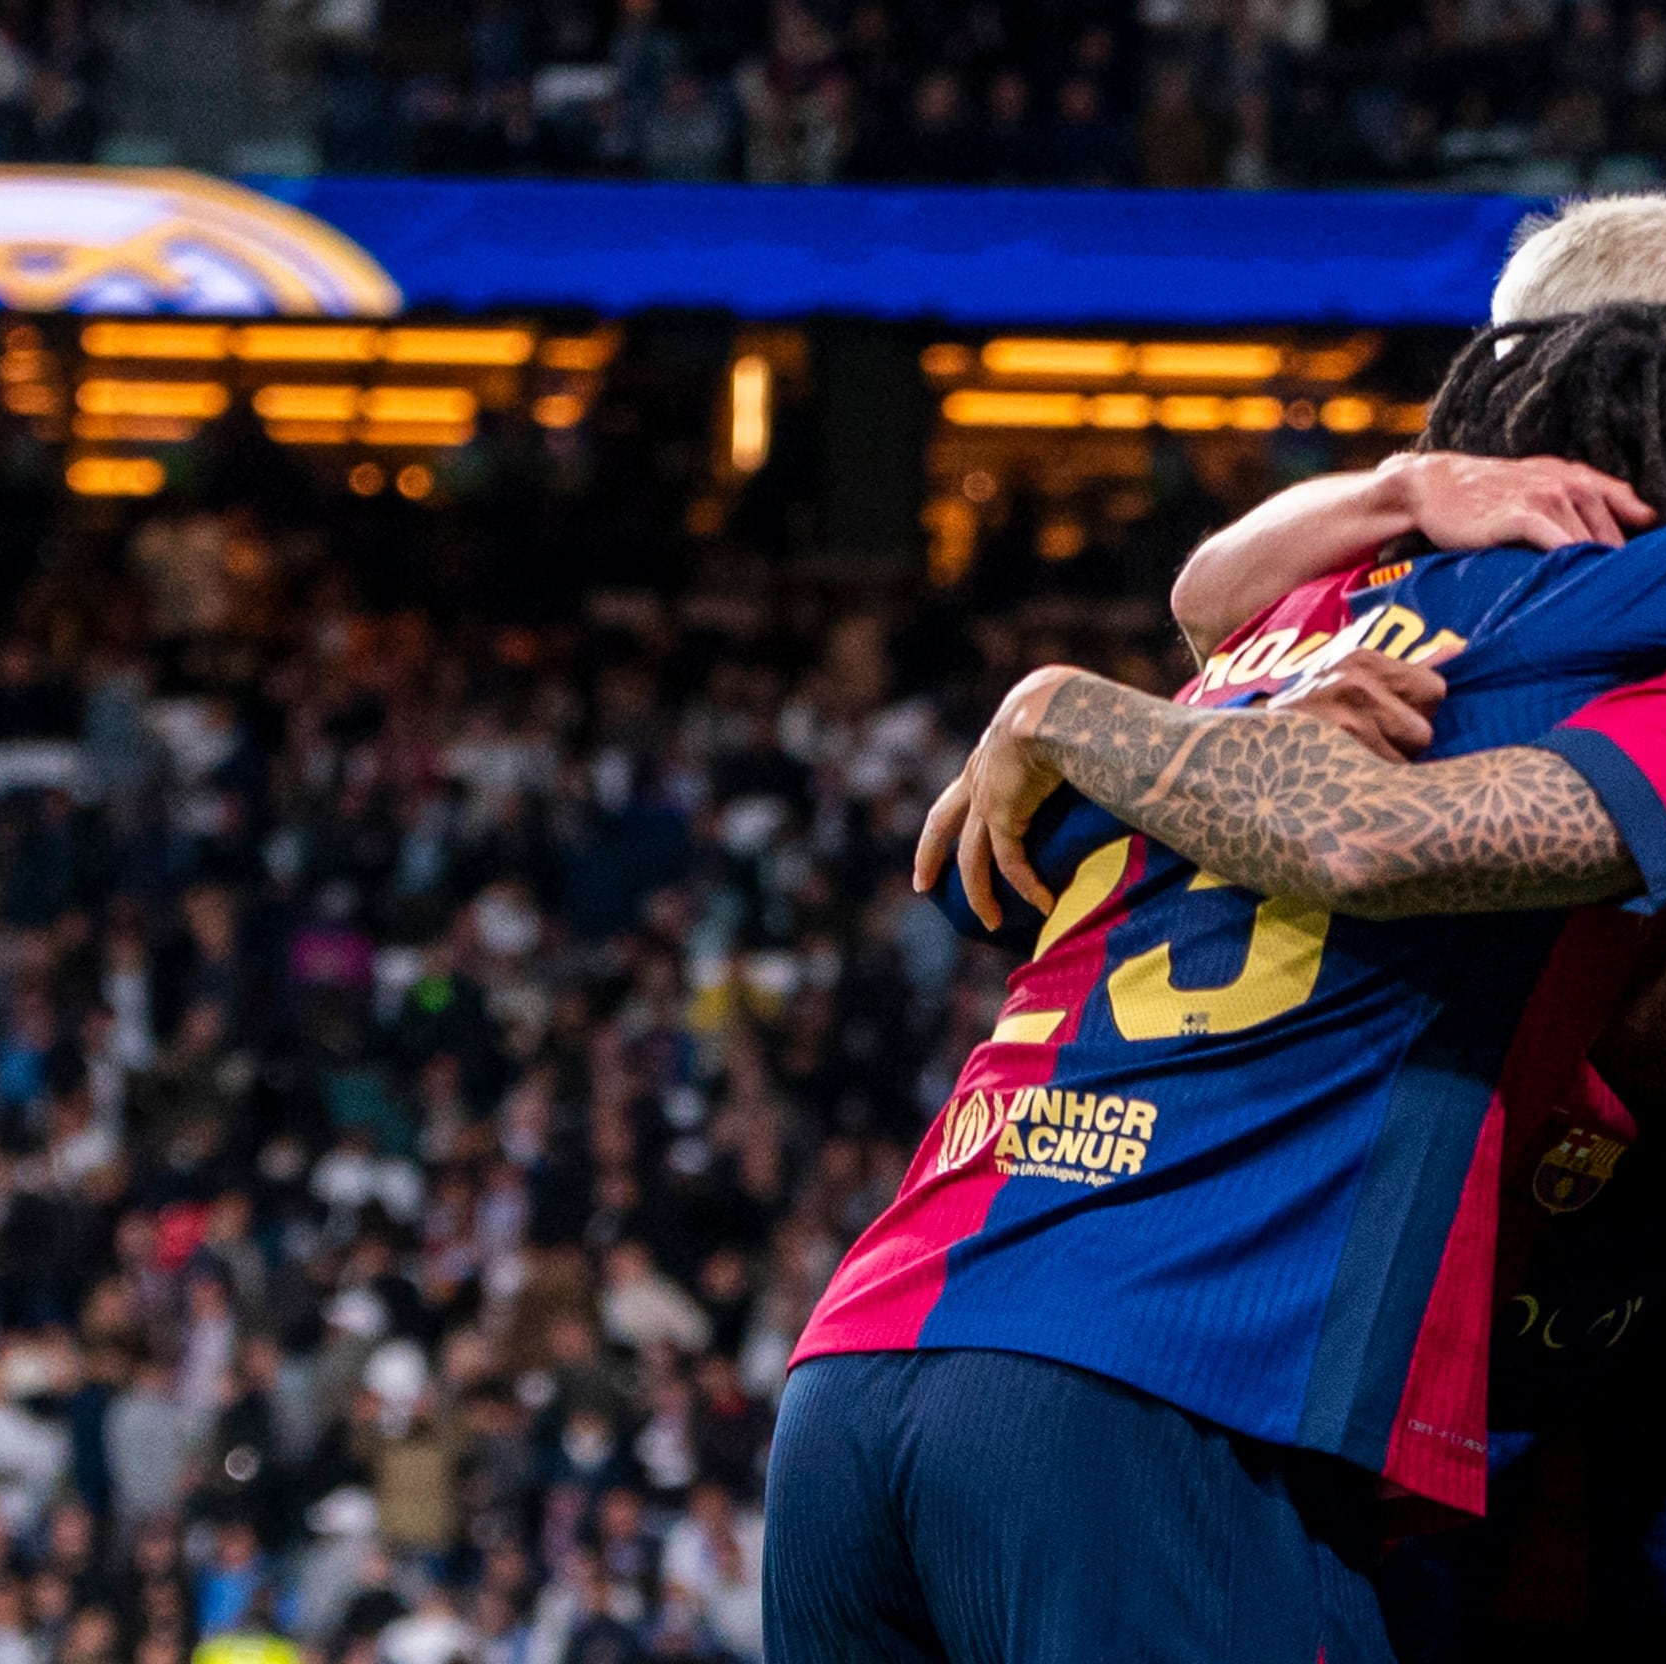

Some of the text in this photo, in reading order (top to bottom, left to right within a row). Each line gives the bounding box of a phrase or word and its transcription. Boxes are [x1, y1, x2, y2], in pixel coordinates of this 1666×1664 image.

[1006, 1086, 1159, 1141] UNHCR
[993, 1121, 1147, 1176] ACNUR
[994, 1158, 1019, 1177] The
